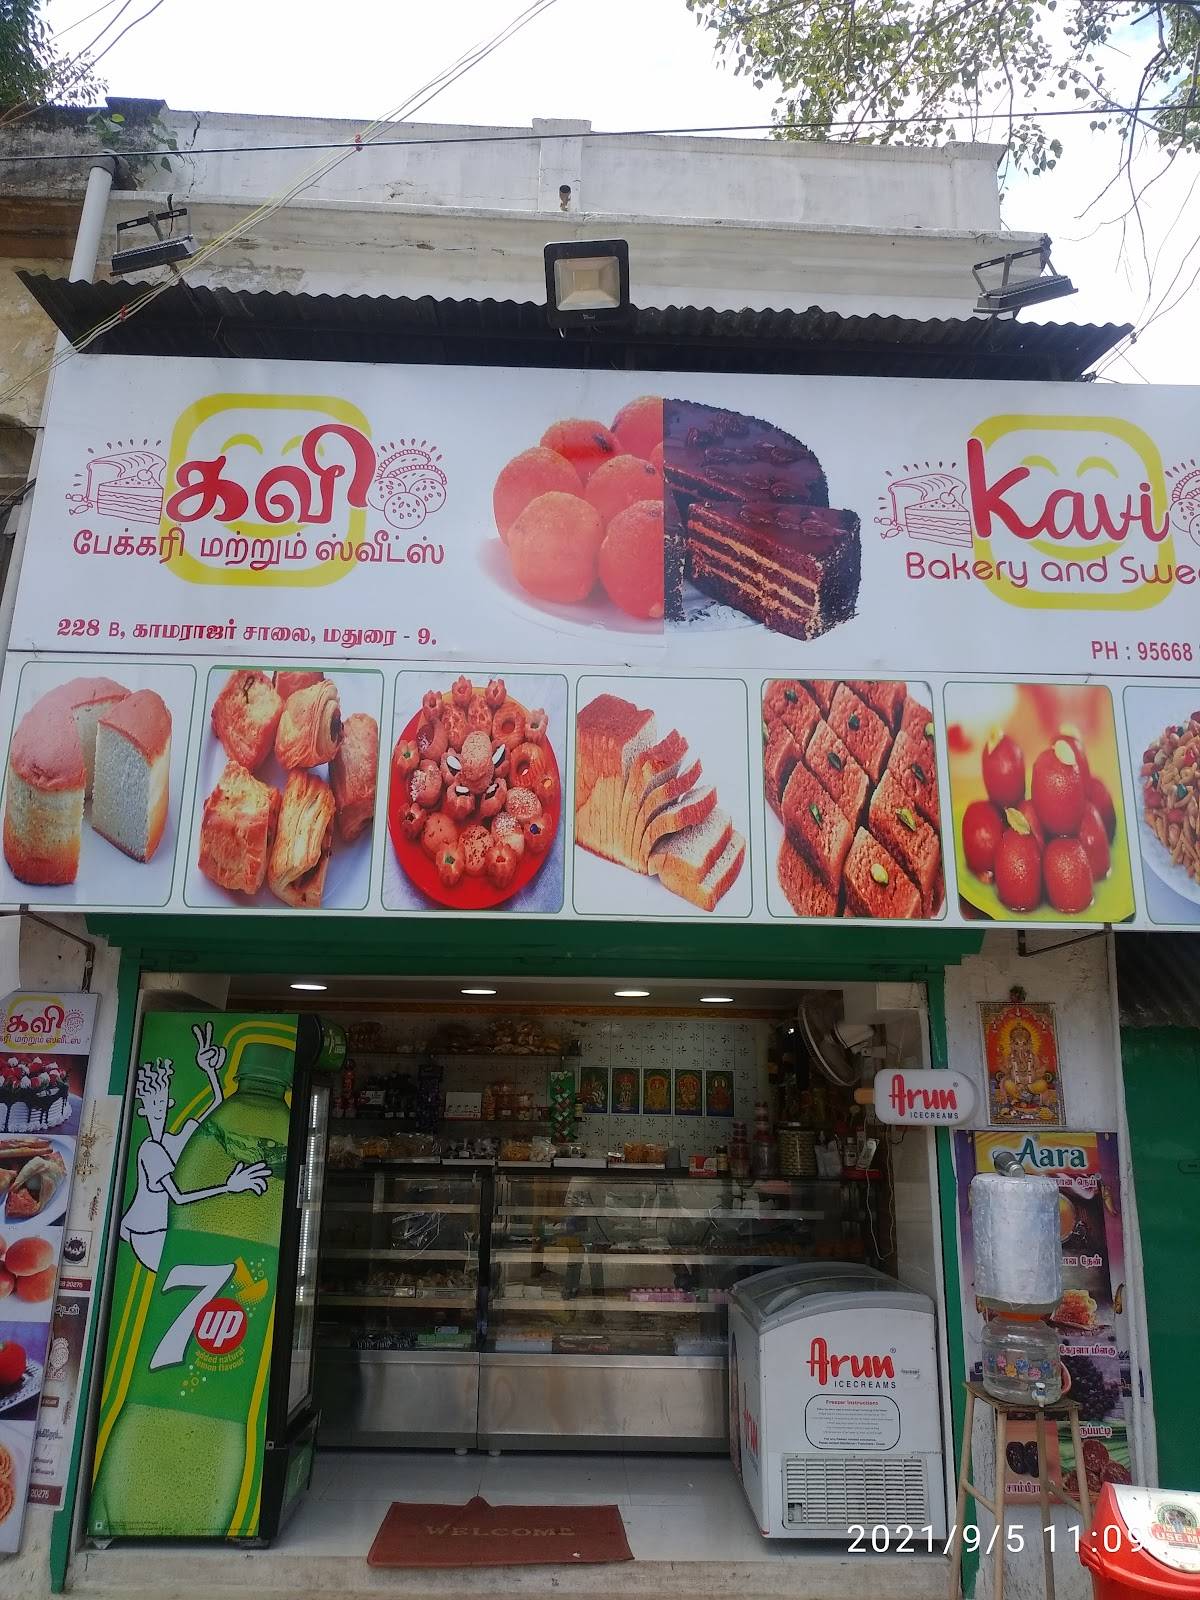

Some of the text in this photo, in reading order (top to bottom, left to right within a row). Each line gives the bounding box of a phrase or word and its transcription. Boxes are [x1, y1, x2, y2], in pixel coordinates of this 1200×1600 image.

[165, 423, 377, 525] கவி
[967, 438, 1170, 542] Kavi
[72, 526, 446, 571] பேக்கரி மற்றும் ஸ்வீட்ஸ்
[905, 551, 1028, 589] Bakery
[1040, 556, 1109, 583] and
[57, 618, 101, 638] 228
[108, 621, 127, 640] B,
[132, 618, 238, 642] காமராஜர்
[242, 626, 317, 645] சாலை,
[323, 627, 398, 649] மதுரை
[417, 627, 438, 646] 9.
[1091, 640, 1119, 660] PH
[1137, 641, 1193, 662] 95668
[7, 1005, 65, 1033] கவி
[888, 1073, 958, 1117] Arun
[910, 1111, 959, 1120] ICECREAMS
[1015, 1138, 1087, 1169] Aara
[150, 1264, 244, 1373] 7 up
[807, 1338, 895, 1385] Arun
[834, 1381, 896, 1389] ICECREAMS
[426, 1523, 575, 1537] WELCOME
